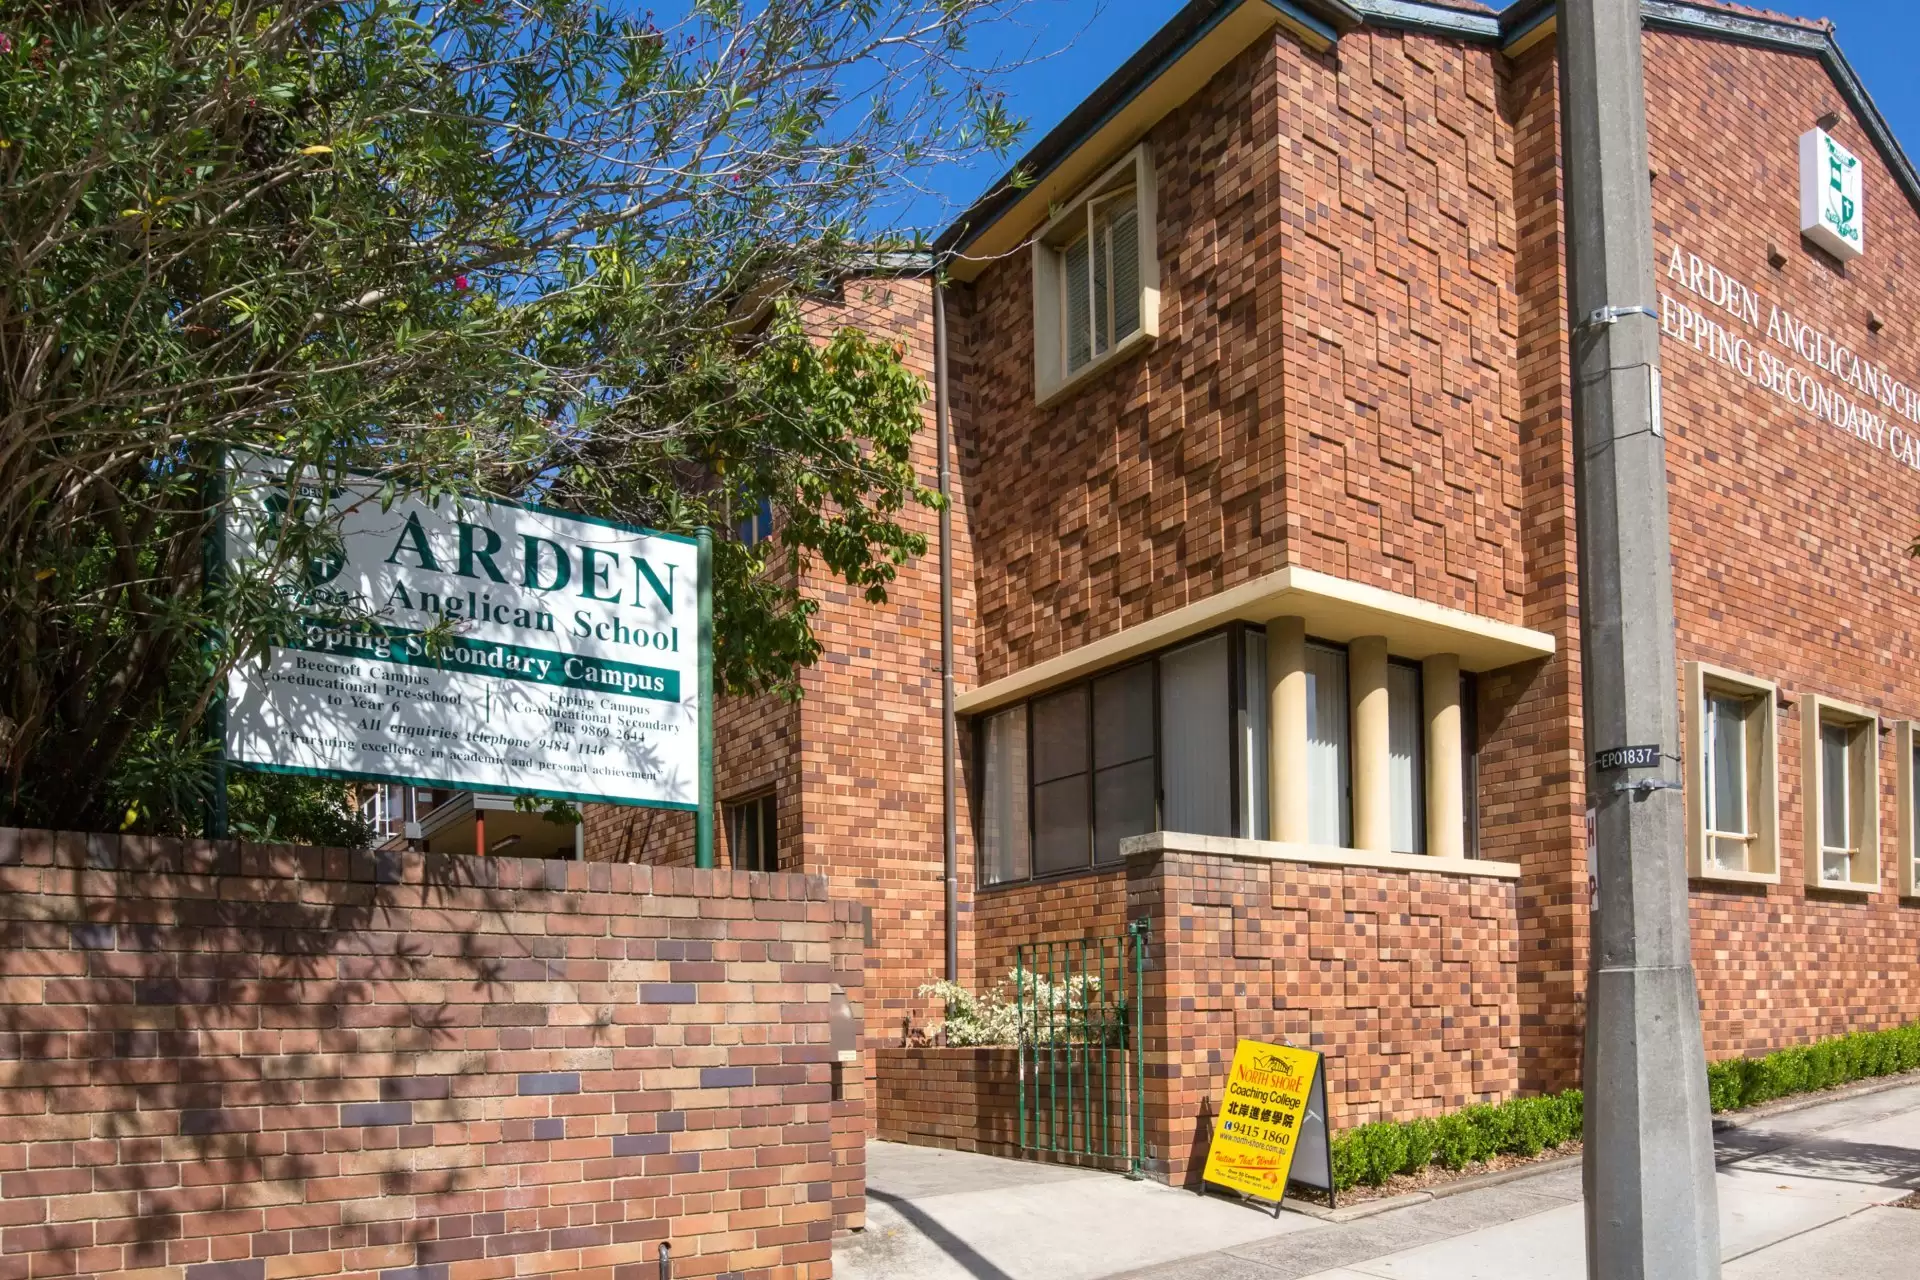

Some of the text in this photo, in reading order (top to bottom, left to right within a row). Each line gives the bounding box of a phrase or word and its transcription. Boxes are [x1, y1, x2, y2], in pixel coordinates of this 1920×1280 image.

[1667, 243, 1920, 424] ARDEN ANGLICAN SCH
[1661, 293, 1753, 377] EPPING
[1758, 350, 1887, 450] SECONDARY
[384, 510, 680, 615] ARDEN
[385, 579, 680, 653] Anglican School
[286, 620, 665, 693] pping Scondary Campus
[296, 656, 430, 687] Beecroft Campus
[264, 672, 462, 705] o-educational Pre-school
[327, 694, 401, 713] to Year 6
[549, 691, 651, 716] Epping Campus
[513, 701, 681, 734] Co-educational Secondary
[553, 720, 646, 743] Ph: 9869 2644
[357, 717, 606, 757] All enquiries telephone 9484 1146
[361, 741, 426, 757] excellence
[431, 747, 444, 759] in
[449, 751, 506, 765] academic
[511, 757, 534, 769] and
[538, 761, 588, 775] personal
[1236, 1064, 1304, 1094] NORTH SHORE
[1230, 1082, 1301, 1110] Coaching College
[1233, 1121, 1290, 1145] 9415 1860
[1214, 1150, 1236, 1164] Tuition
[1238, 1154, 1254, 1166] That
